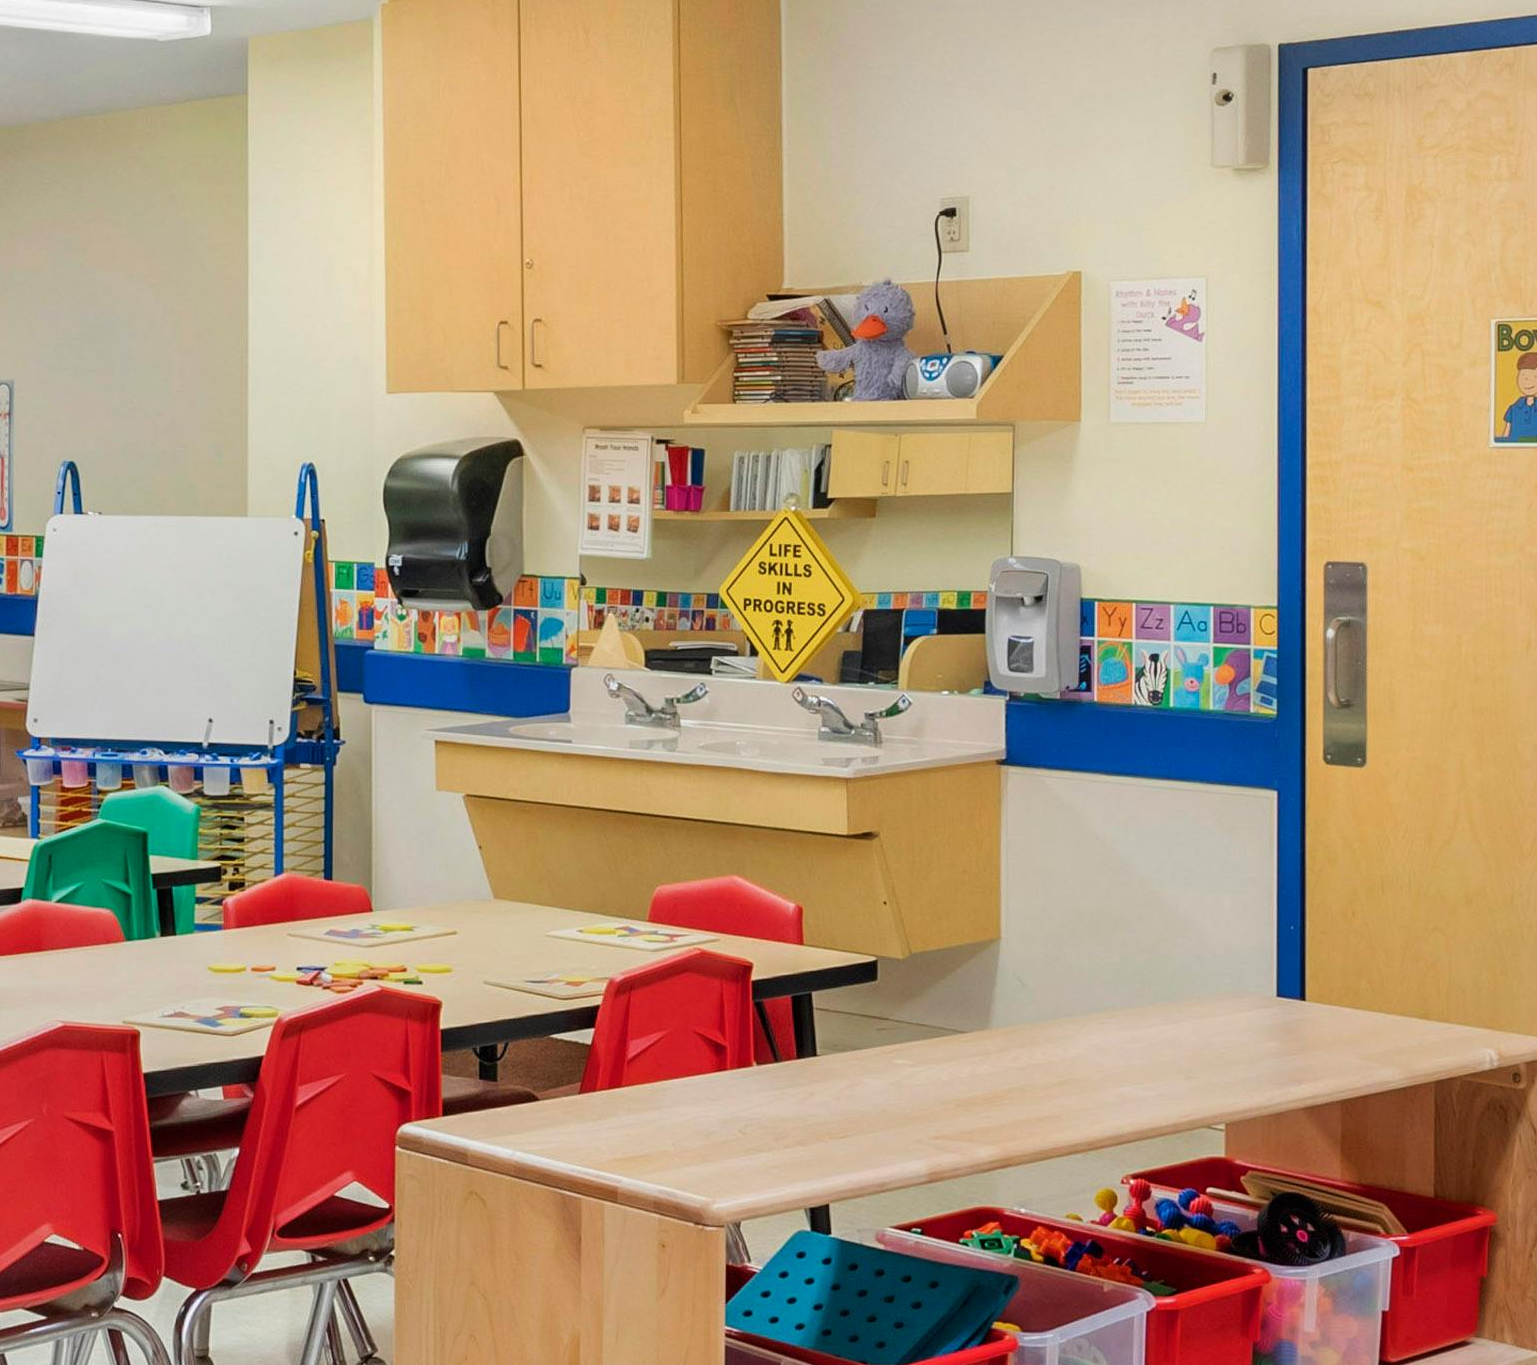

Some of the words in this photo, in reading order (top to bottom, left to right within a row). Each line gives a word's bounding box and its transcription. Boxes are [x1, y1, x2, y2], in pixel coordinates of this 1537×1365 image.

[769, 544, 802, 558] LIFE
[758, 562, 812, 578] SKILLS
[542, 585, 562, 600] Uu
[777, 582, 792, 595] IN
[743, 598, 826, 616] PROGRESS
[1103, 607, 1127, 637] Yy
[1140, 608, 1164, 630] Zz
[1177, 611, 1207, 631] Aa
[1219, 612, 1247, 634] Bb
